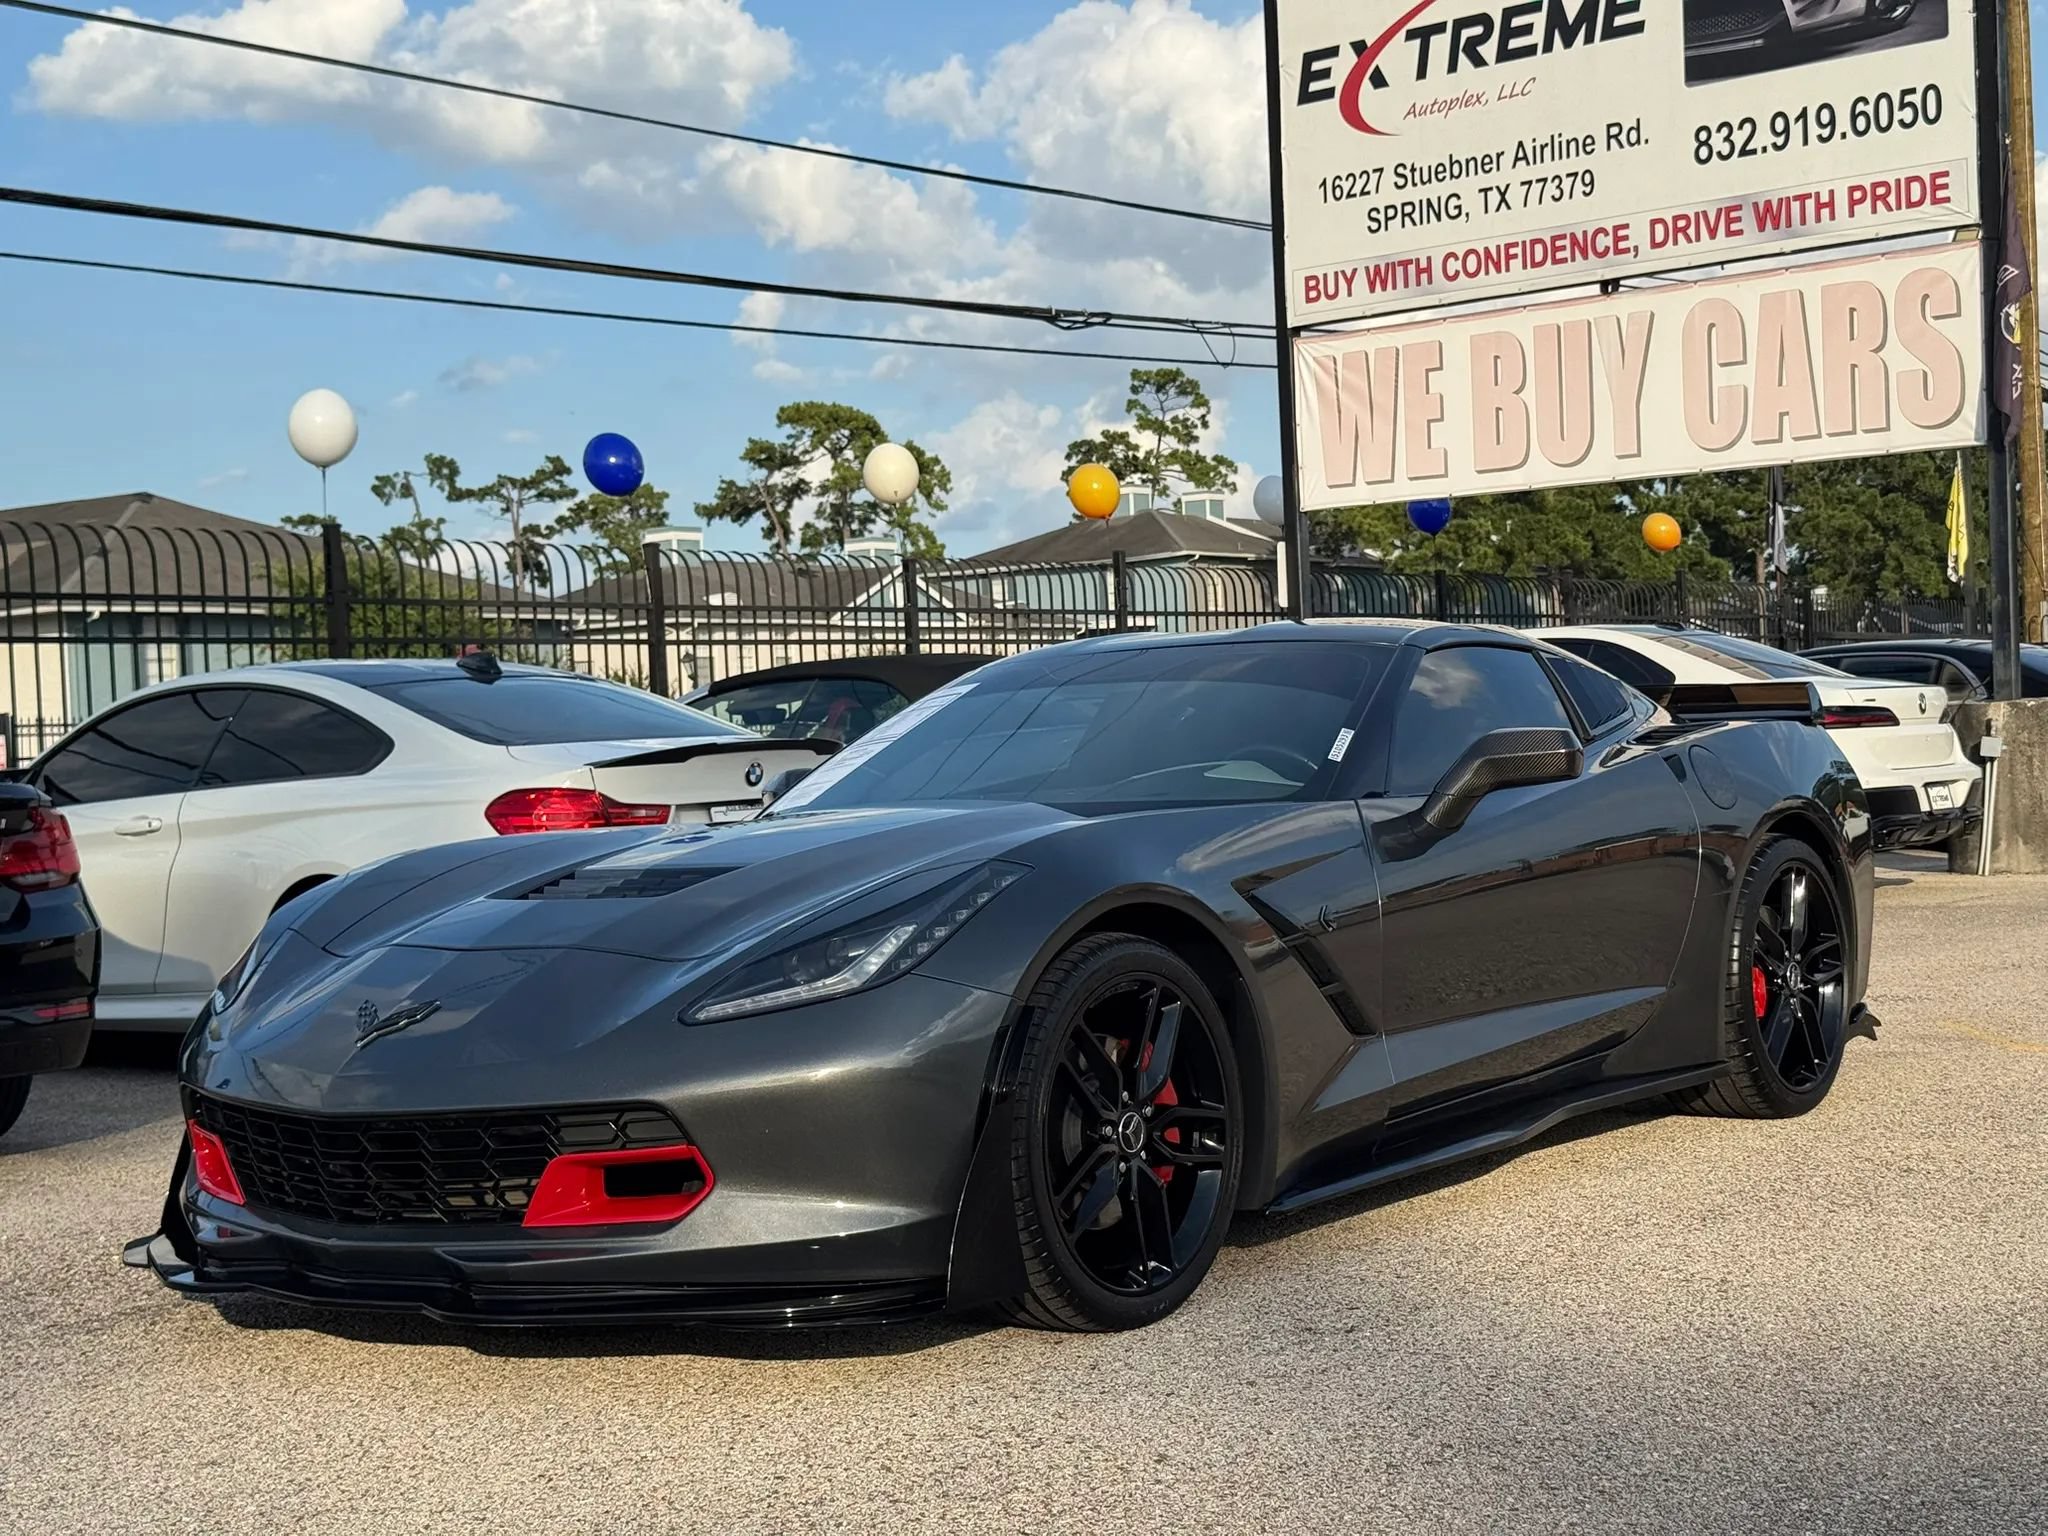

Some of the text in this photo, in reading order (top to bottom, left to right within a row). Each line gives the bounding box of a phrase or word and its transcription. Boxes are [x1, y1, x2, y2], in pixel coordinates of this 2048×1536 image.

[1297, 0, 1646, 134] EXTREME
[1402, 76, 1537, 121] Autoplex, LLC
[1318, 117, 1650, 204] 16227 Stuebner Airline Rd.
[1693, 83, 1943, 166] 832.919.6050
[1304, 170, 1950, 304] BUY WITH CONFIDENCE, DRIVE WITH PRIDE
[1366, 169, 1596, 234] SPRING, TX 77379
[1312, 266, 1966, 489] WE BUY CARS
